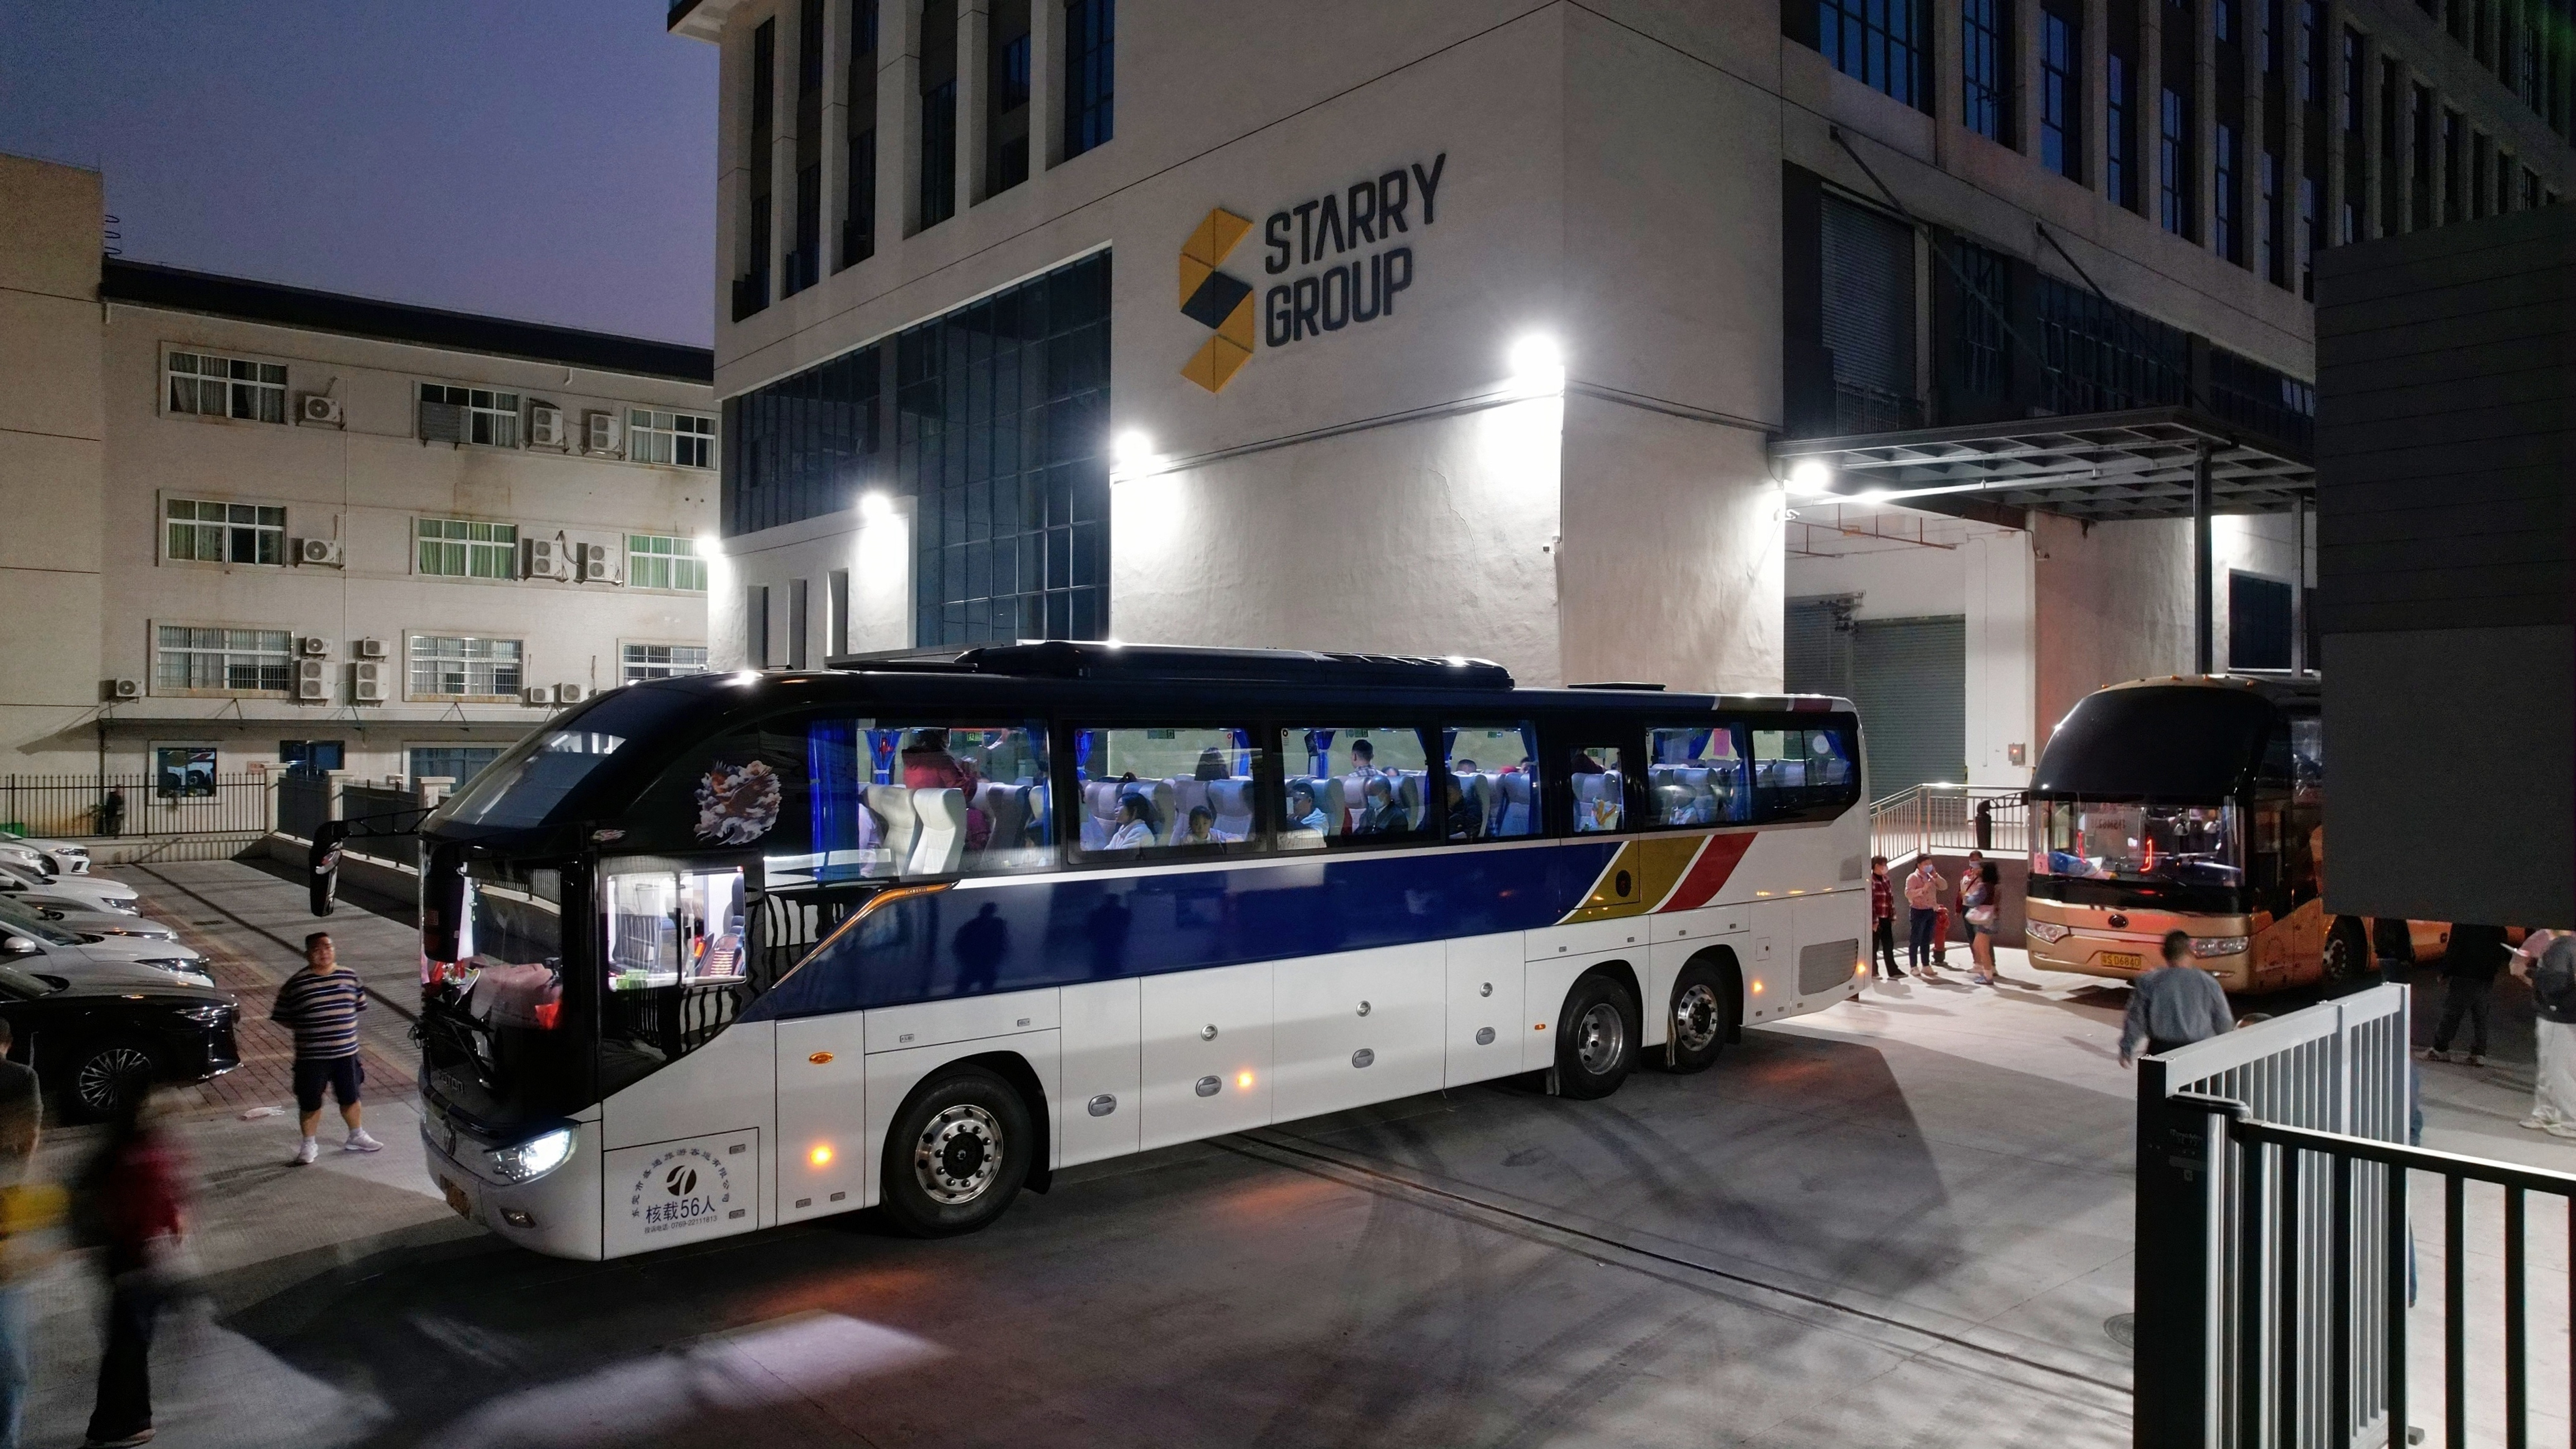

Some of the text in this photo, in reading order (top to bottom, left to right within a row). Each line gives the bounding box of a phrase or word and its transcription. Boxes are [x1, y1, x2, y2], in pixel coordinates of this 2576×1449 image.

[1265, 153, 1446, 275] STARRY
[1266, 246, 1413, 348] GROUP
[646, 1195, 715, 1224] 核载56人
[671, 1215, 717, 1229] 0769-22111813
